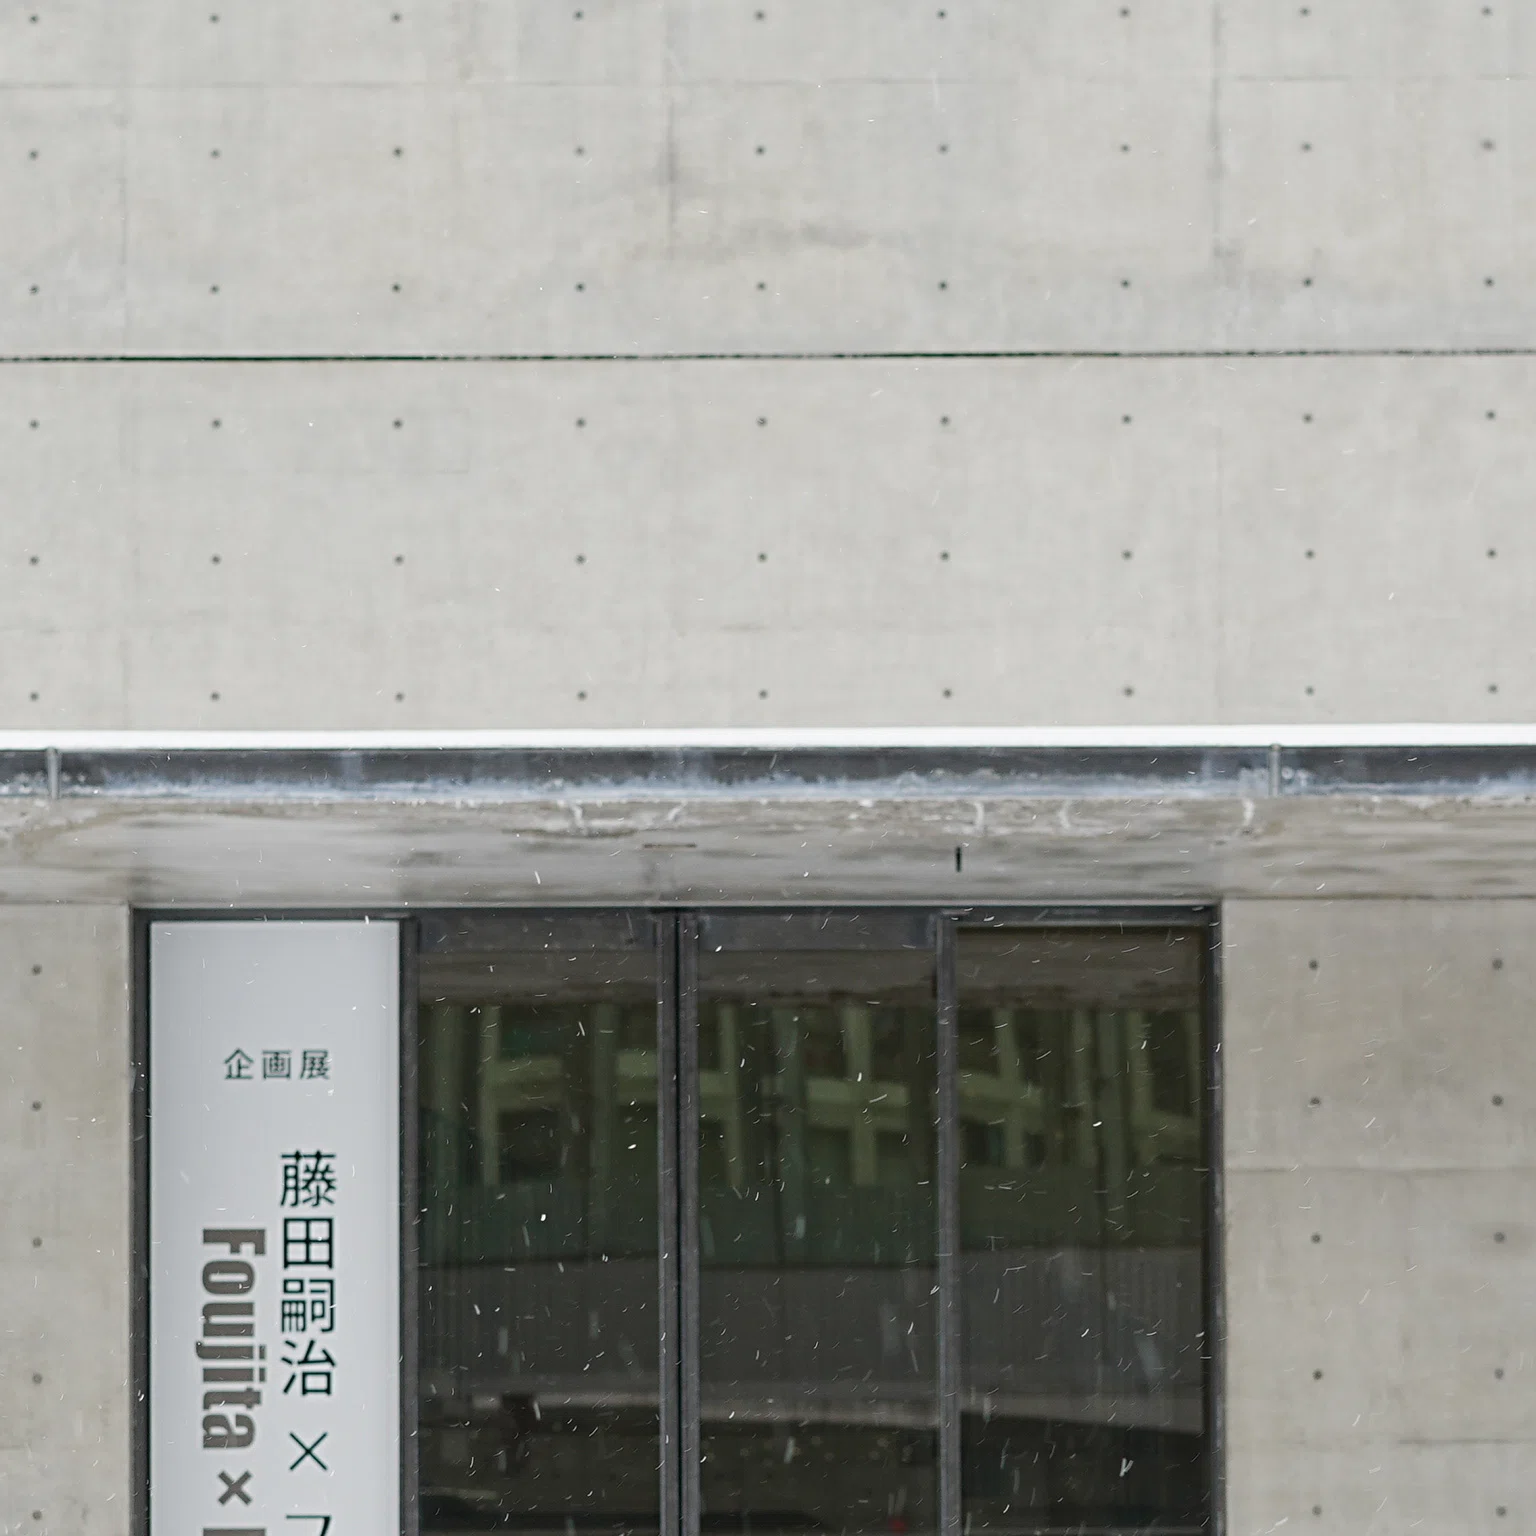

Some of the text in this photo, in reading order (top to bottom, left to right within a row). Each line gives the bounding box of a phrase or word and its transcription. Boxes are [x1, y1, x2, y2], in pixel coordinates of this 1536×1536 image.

[225, 1049, 328, 1079] 企画展
[196, 1229, 265, 1448] Foujita
